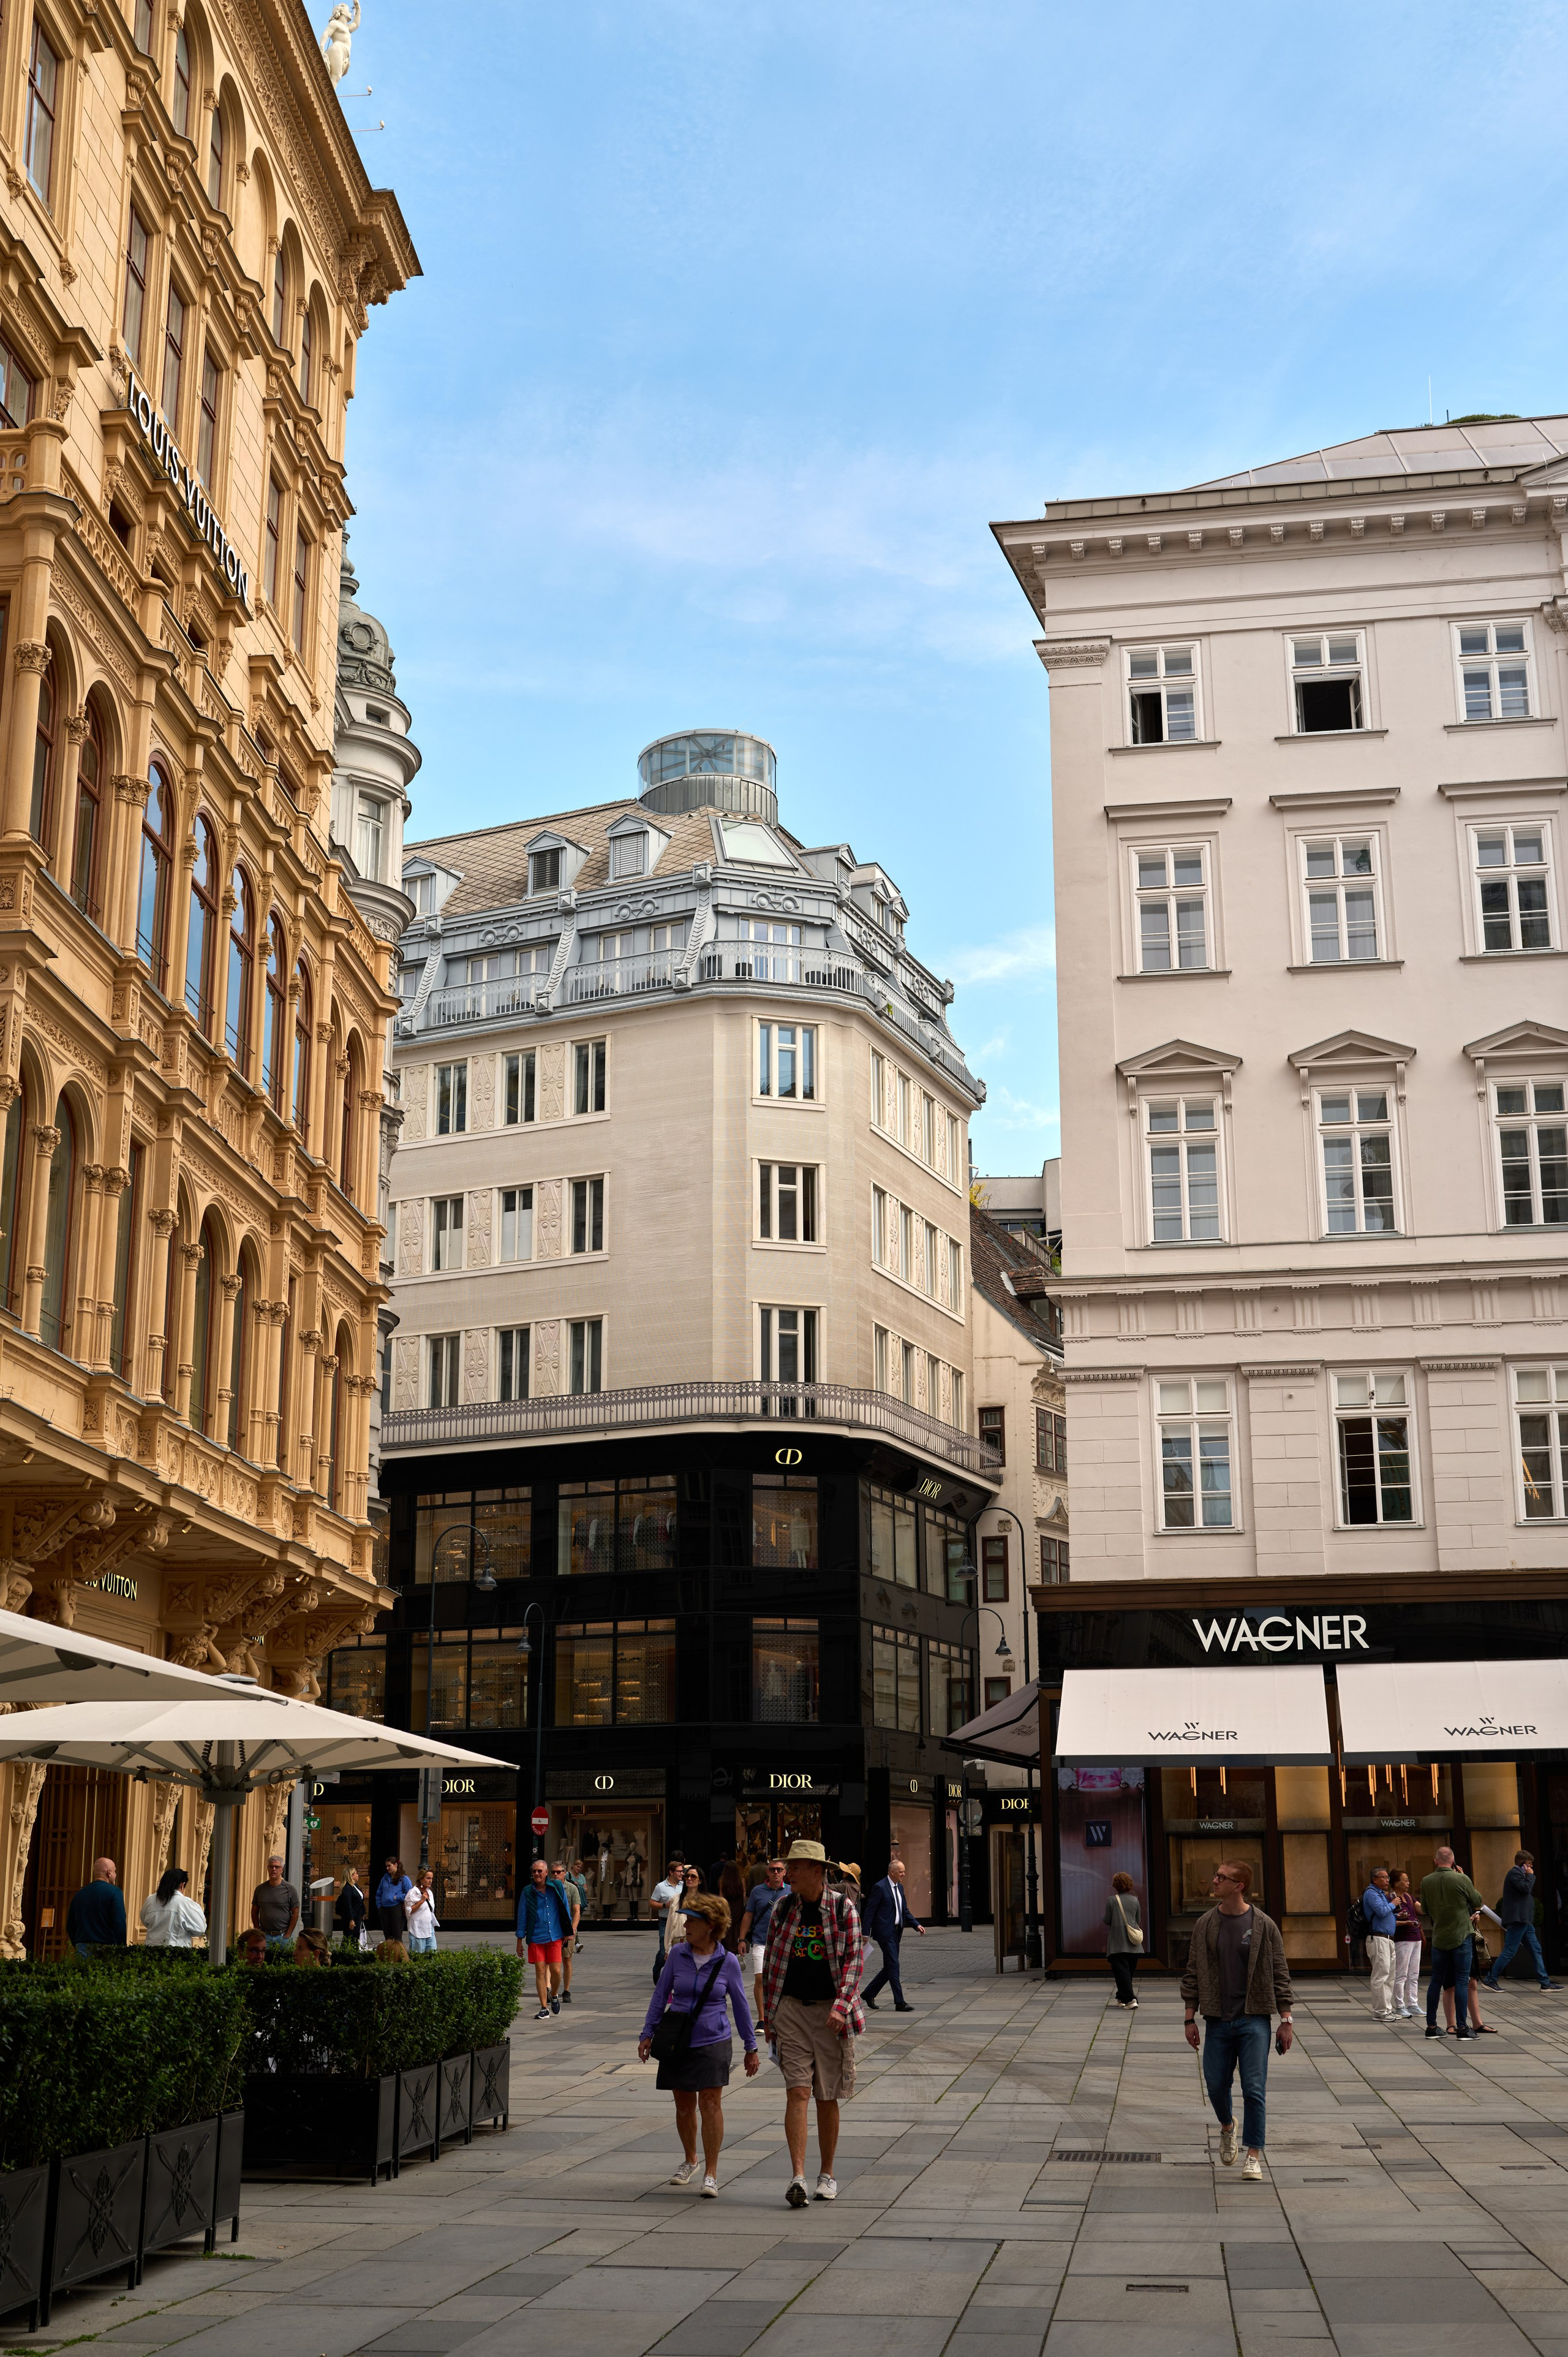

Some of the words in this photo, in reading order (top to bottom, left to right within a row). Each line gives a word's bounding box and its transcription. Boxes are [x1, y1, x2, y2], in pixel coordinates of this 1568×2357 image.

[127, 371, 179, 485] LOUIS
[183, 466, 248, 606] VUITTON
[918, 1478, 942, 1499] DIOR
[101, 1572, 138, 1601] VUITTON
[1192, 1614, 1370, 1653] WAGNER
[1147, 1731, 1238, 1741] WAGNER
[1443, 1725, 1539, 1736] WAGNER
[440, 1779, 476, 1793] DIOR
[769, 1774, 813, 1788] DIOR
[948, 1784, 962, 1798] DIOR
